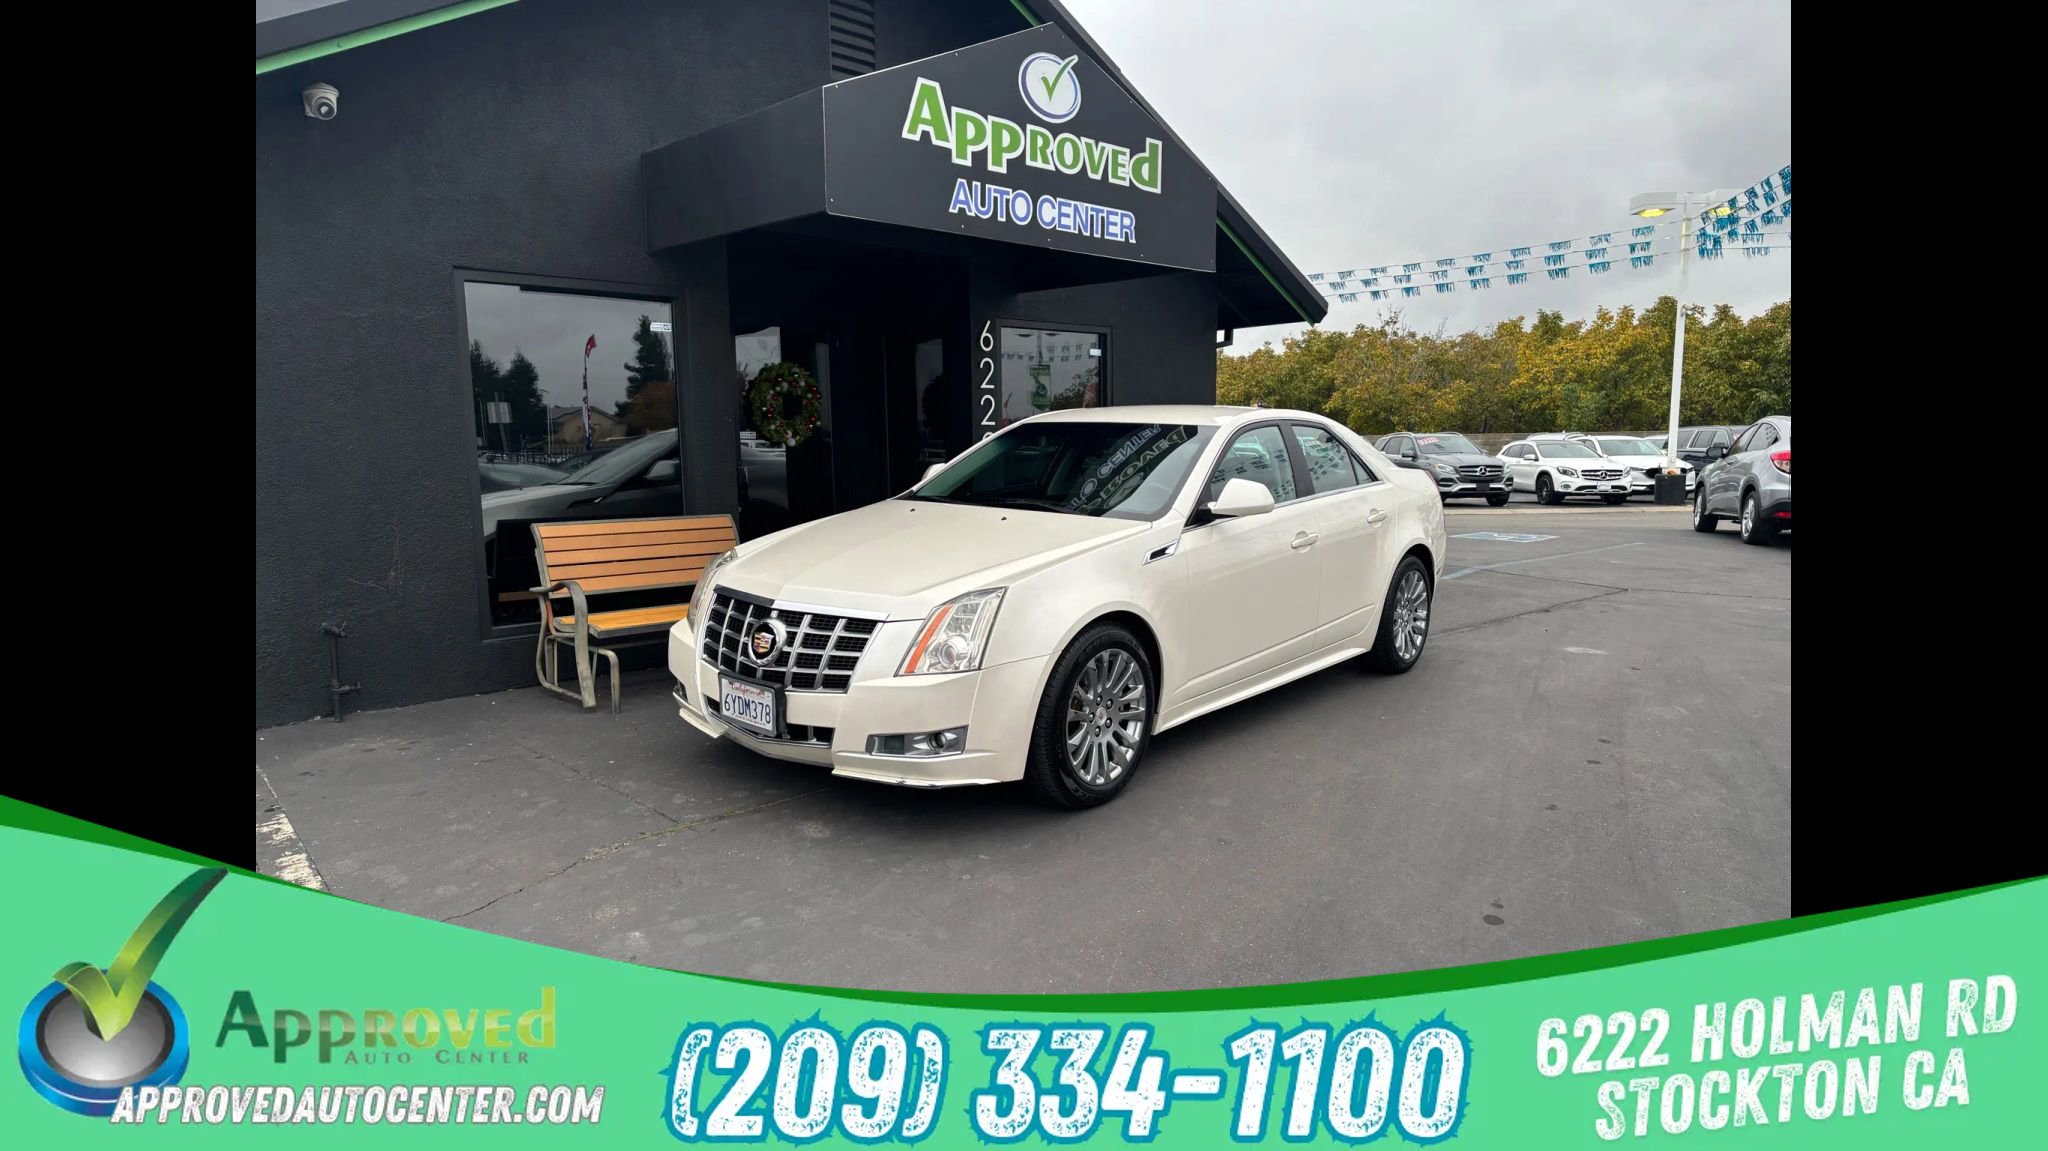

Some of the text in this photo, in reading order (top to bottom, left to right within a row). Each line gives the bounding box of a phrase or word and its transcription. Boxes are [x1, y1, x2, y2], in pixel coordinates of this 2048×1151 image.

[949, 178, 1136, 243] AUTO CENTER
[724, 693, 772, 724] 6YDM378
